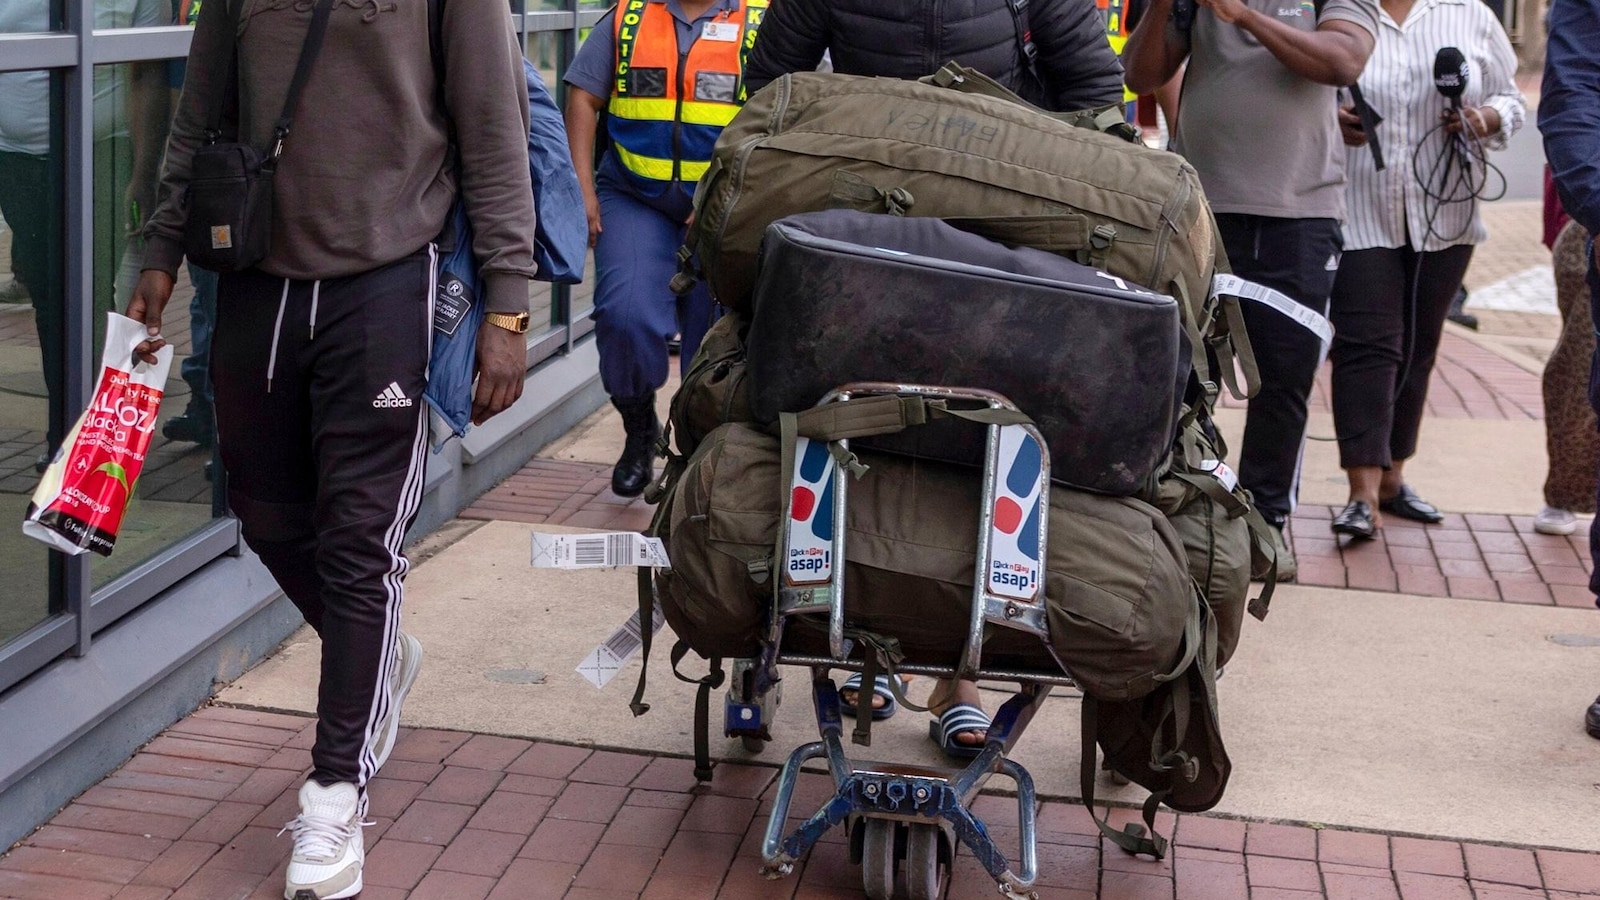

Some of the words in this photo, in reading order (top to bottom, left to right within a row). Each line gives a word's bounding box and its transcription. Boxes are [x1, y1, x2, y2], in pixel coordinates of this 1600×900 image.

[1278, 8, 1302, 16] SABC
[617, 1, 643, 92] POLICE
[141, 390, 160, 405] Free
[373, 397, 413, 408] adidas
[790, 550, 829, 573] asap!
[992, 570, 1036, 591] asap!
